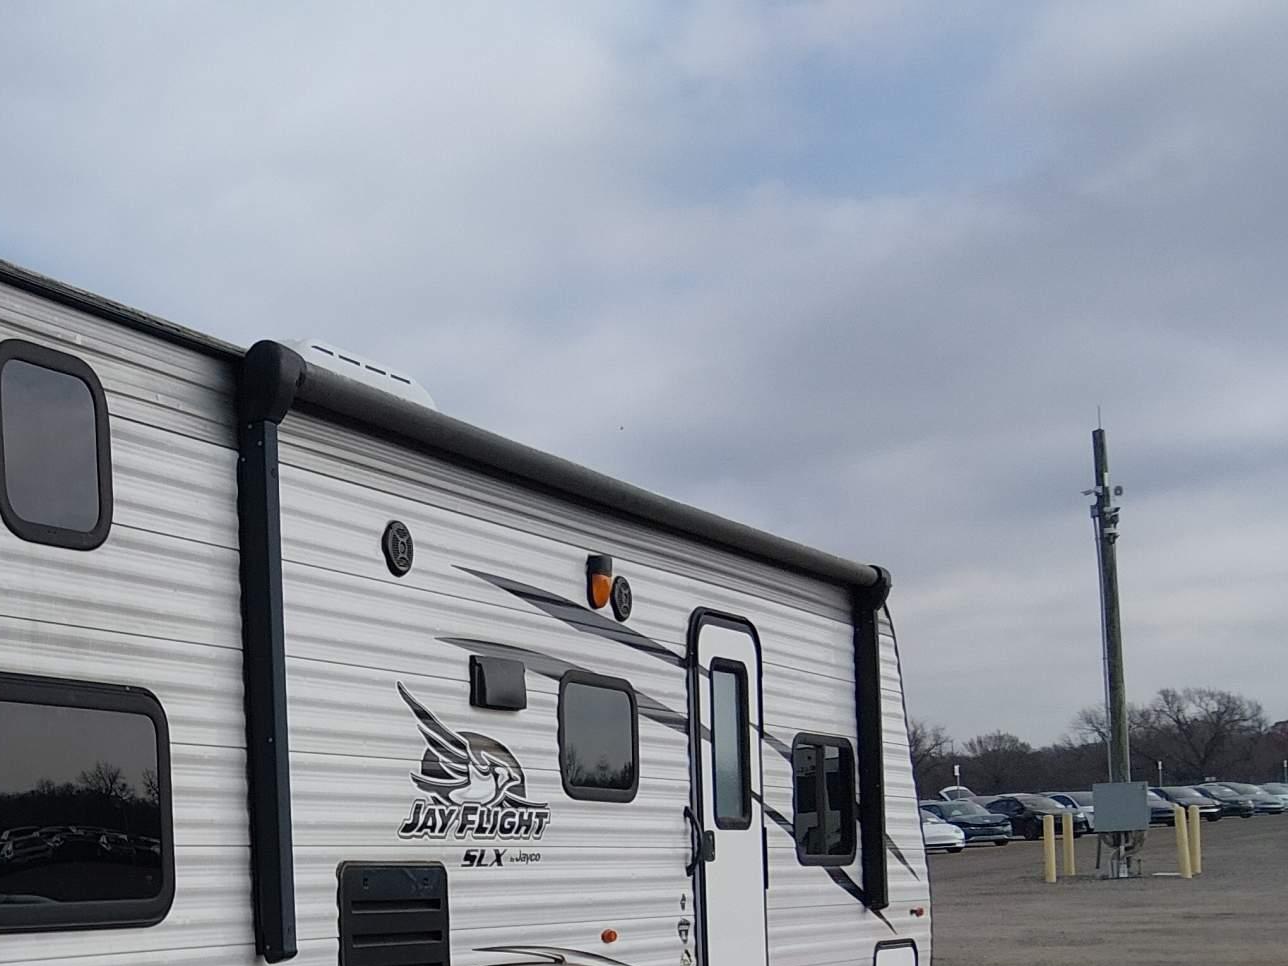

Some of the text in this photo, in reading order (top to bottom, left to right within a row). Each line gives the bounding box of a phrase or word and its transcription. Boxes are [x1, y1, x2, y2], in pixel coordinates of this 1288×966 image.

[398, 799, 550, 839] JAY FLIGHT
[461, 848, 541, 868] SLX Jayco
